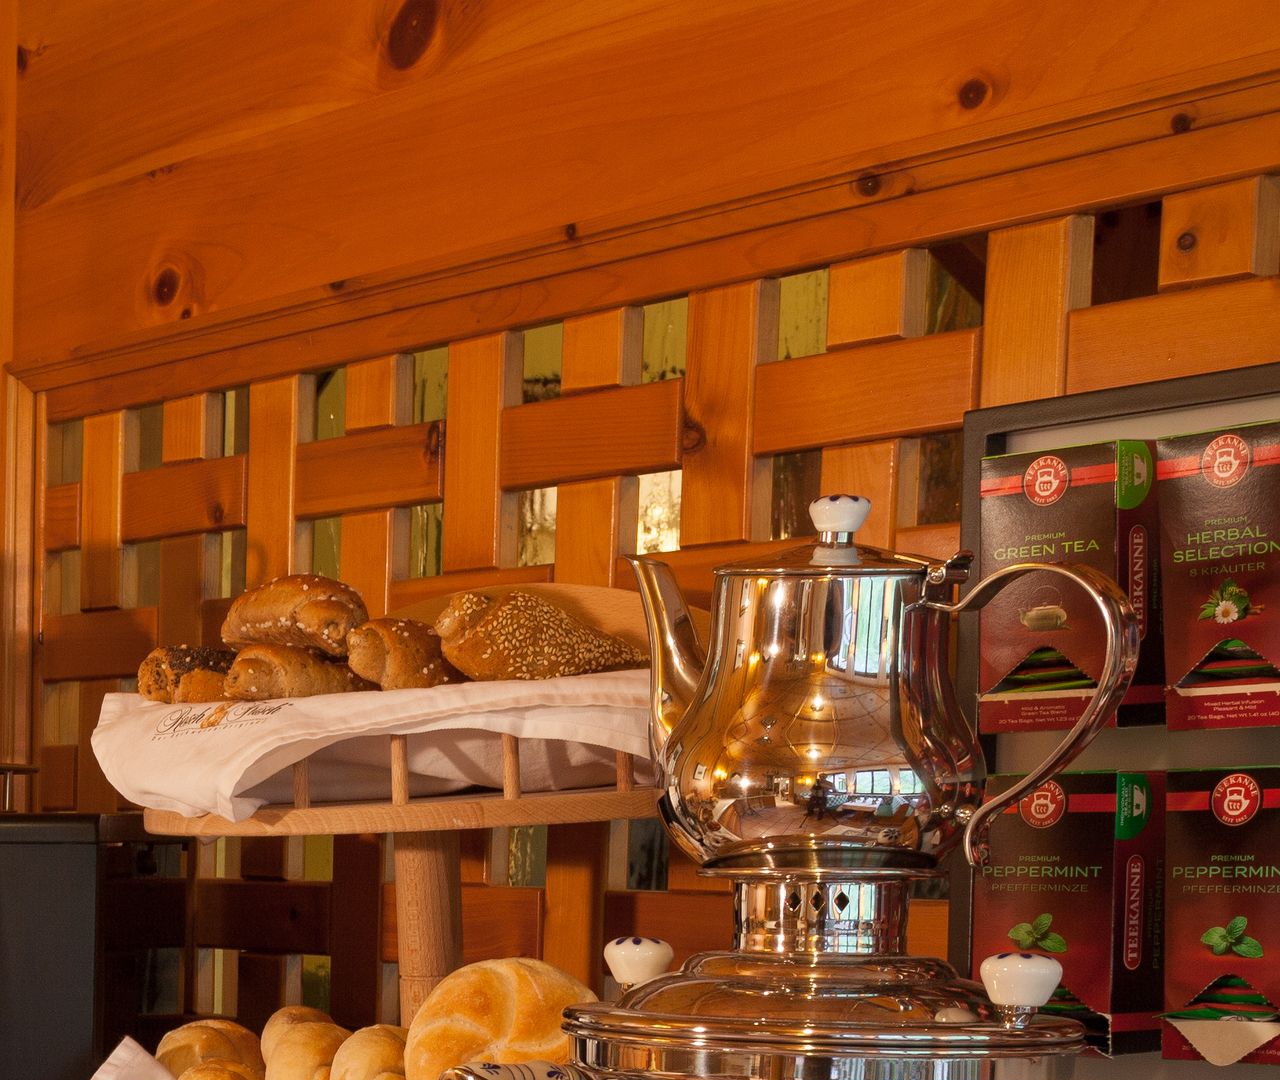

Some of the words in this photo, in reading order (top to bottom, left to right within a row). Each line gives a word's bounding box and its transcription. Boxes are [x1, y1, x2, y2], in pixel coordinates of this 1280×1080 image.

[1205, 437, 1248, 461] TEEKANNE
[1026, 458, 1067, 481] TEEKANNE
[1204, 516, 1248, 527] PREMIUM
[1025, 531, 1066, 542] PREMIUM
[1187, 526, 1268, 545] HERBAL
[994, 543, 1055, 560] GREEN
[1061, 539, 1100, 553] TEA
[1173, 540, 1280, 563] SELECTION
[1215, 776, 1258, 798] TEEKANNE
[1019, 855, 1060, 863] PREMIUM
[982, 866, 1102, 878] PEPPERMINT
[992, 883, 1088, 893] PFEFFERMINZE
[1127, 862, 1141, 962] TEEKANNE
